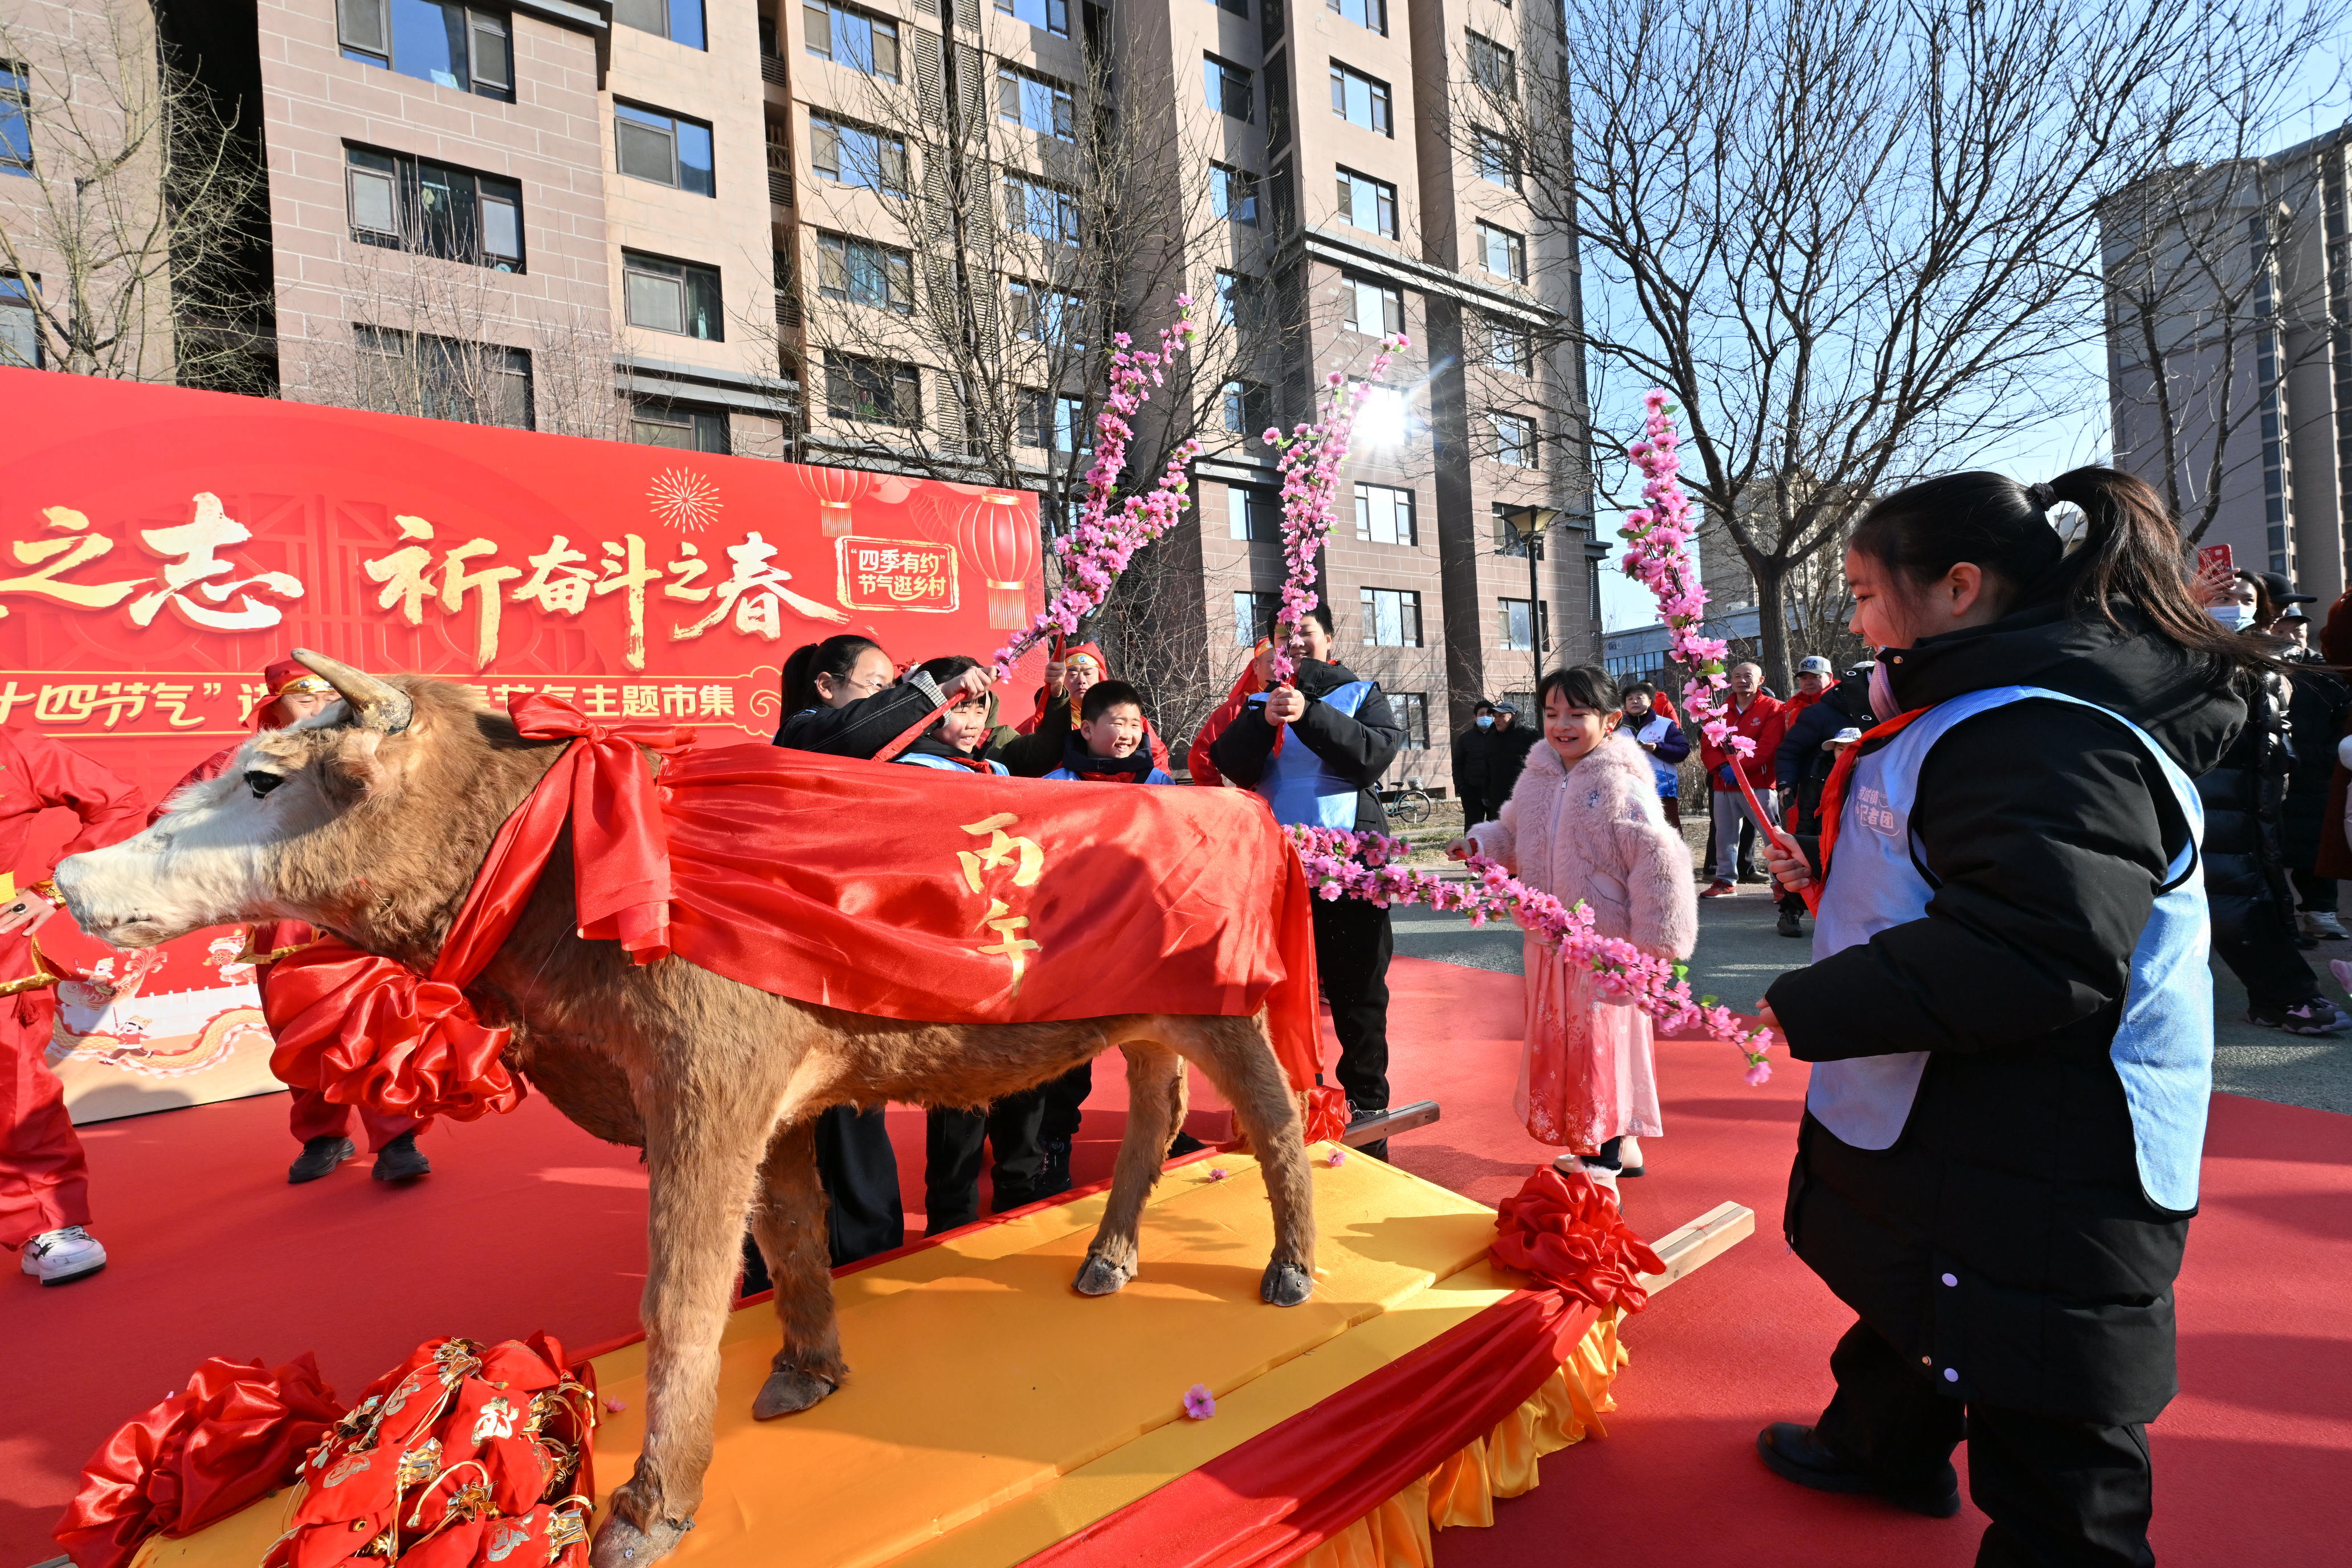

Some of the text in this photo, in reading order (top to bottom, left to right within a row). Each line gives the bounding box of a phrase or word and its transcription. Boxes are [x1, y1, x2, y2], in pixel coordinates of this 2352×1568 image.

[0, 492, 852, 670] 之志 祈奋斗之春
[851, 549, 946, 577] “四季有约”
[858, 574, 946, 601] 节气逛乡村
[956, 812, 1045, 999] 丙午
